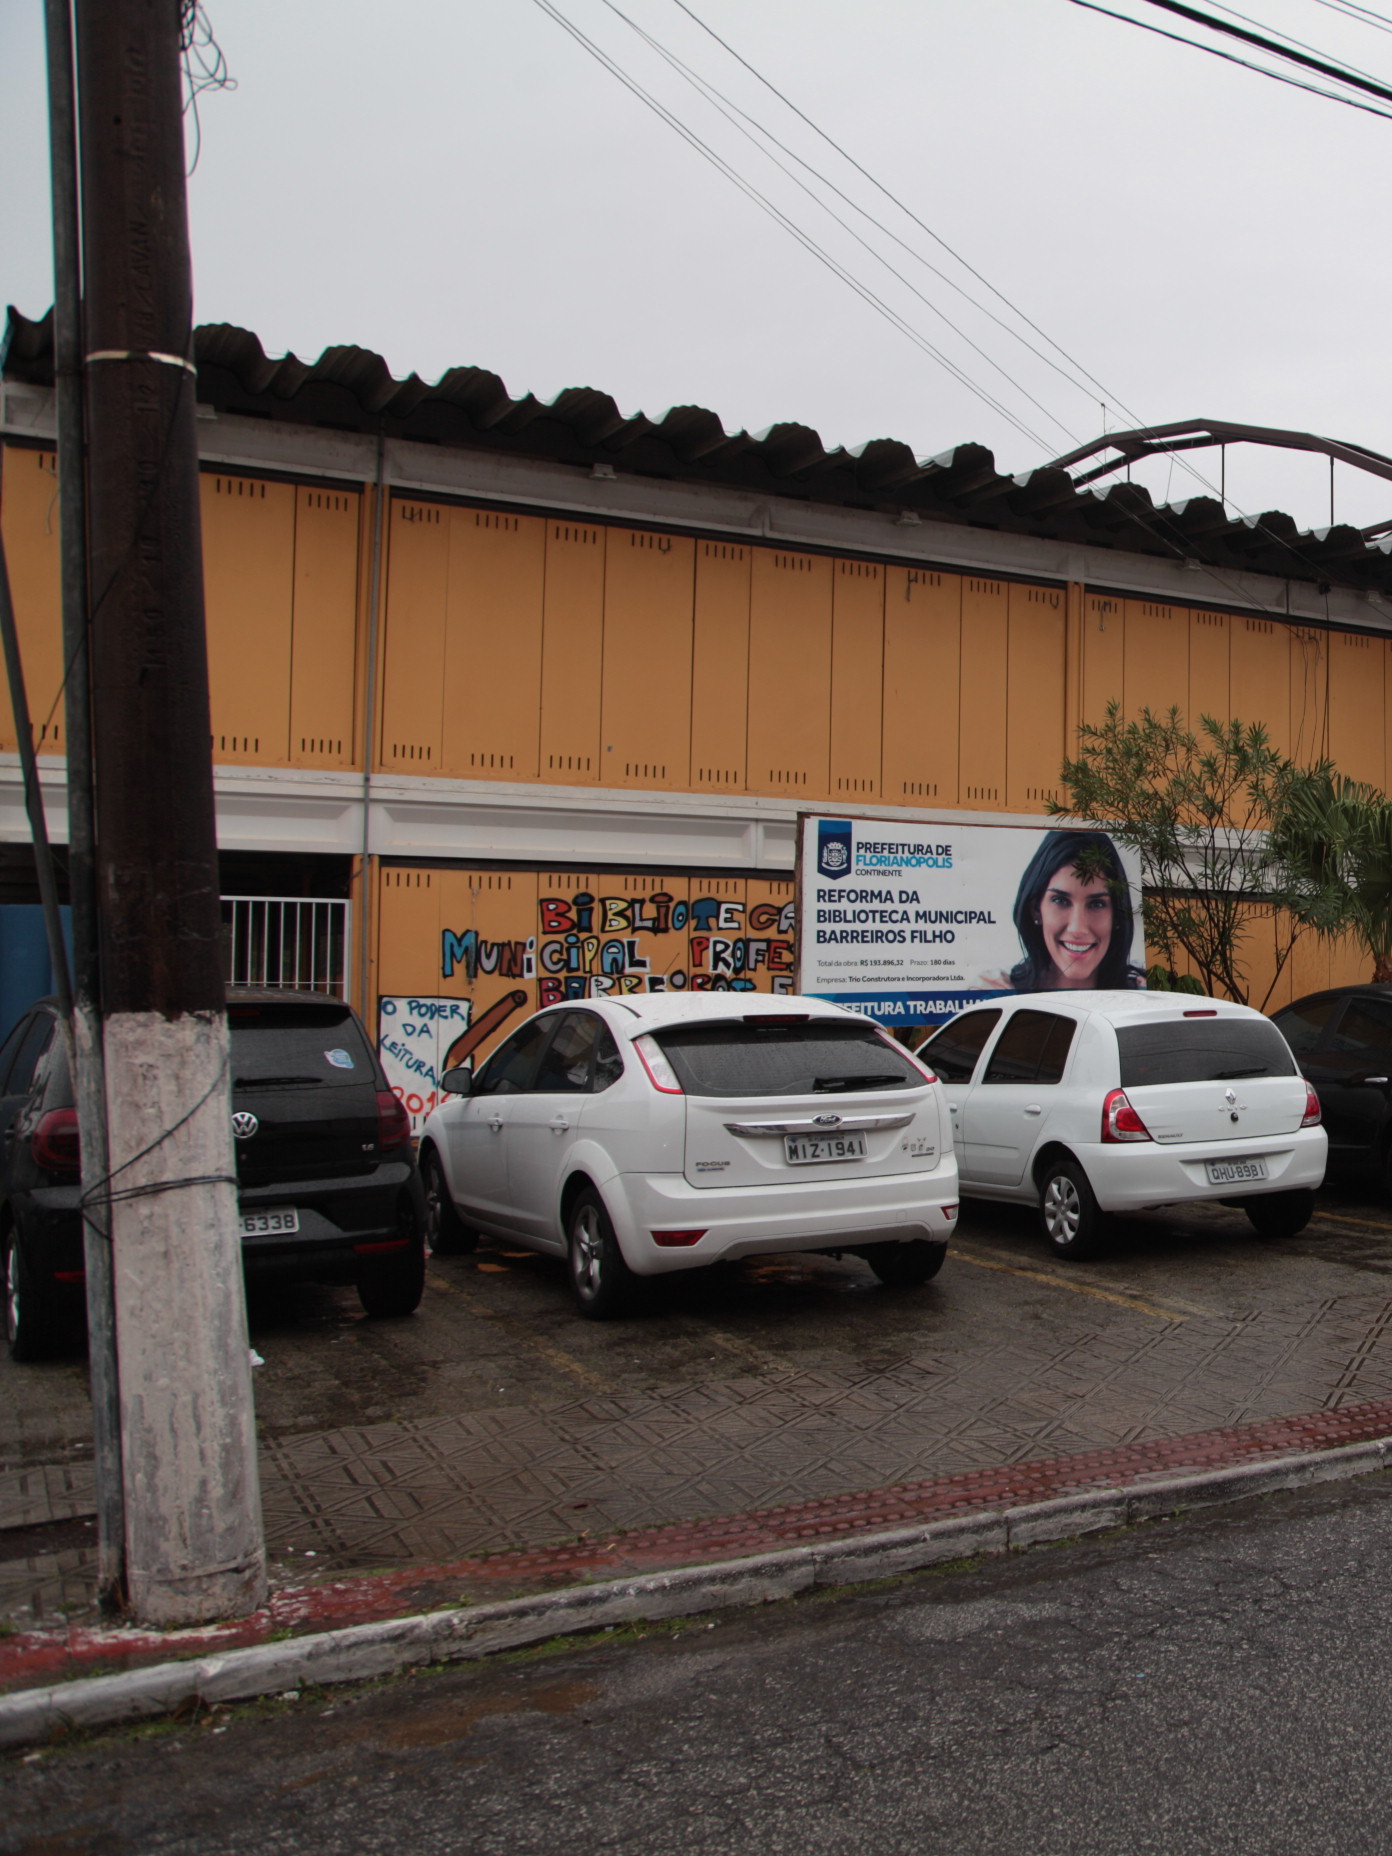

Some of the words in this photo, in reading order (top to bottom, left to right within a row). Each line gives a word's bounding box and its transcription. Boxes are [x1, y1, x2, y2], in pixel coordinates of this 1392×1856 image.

[856, 841, 934, 856] PREFEITURA
[935, 844, 953, 857] DE
[855, 854, 953, 869] FLORIANÓPOLIS
[855, 868, 903, 877] CONTINENTE
[816, 888, 894, 904] REFORMA
[898, 890, 921, 904] DA
[816, 909, 911, 924] BIBLIOTECA
[914, 910, 997, 925] MUNICIPAL
[816, 929, 907, 944] BARREIROS
[910, 930, 956, 944] FILHO
[816, 959, 833, 967] Total
[834, 959, 842, 967] da
[859, 959, 869, 967] R$
[930, 958, 941, 966] 180
[942, 958, 956, 966] dias
[816, 976, 848, 984] Empresa:
[848, 975, 861, 983] Trio
[861, 975, 901, 983] Construtora
[906, 974, 950, 983] Incorporadora
[950, 974, 966, 982] Ltda.
[382, 1000, 397, 1016] O
[407, 1000, 465, 1021] PODER
[402, 1023, 433, 1039] DA
[1217, 1104, 1248, 1112] CLIO
